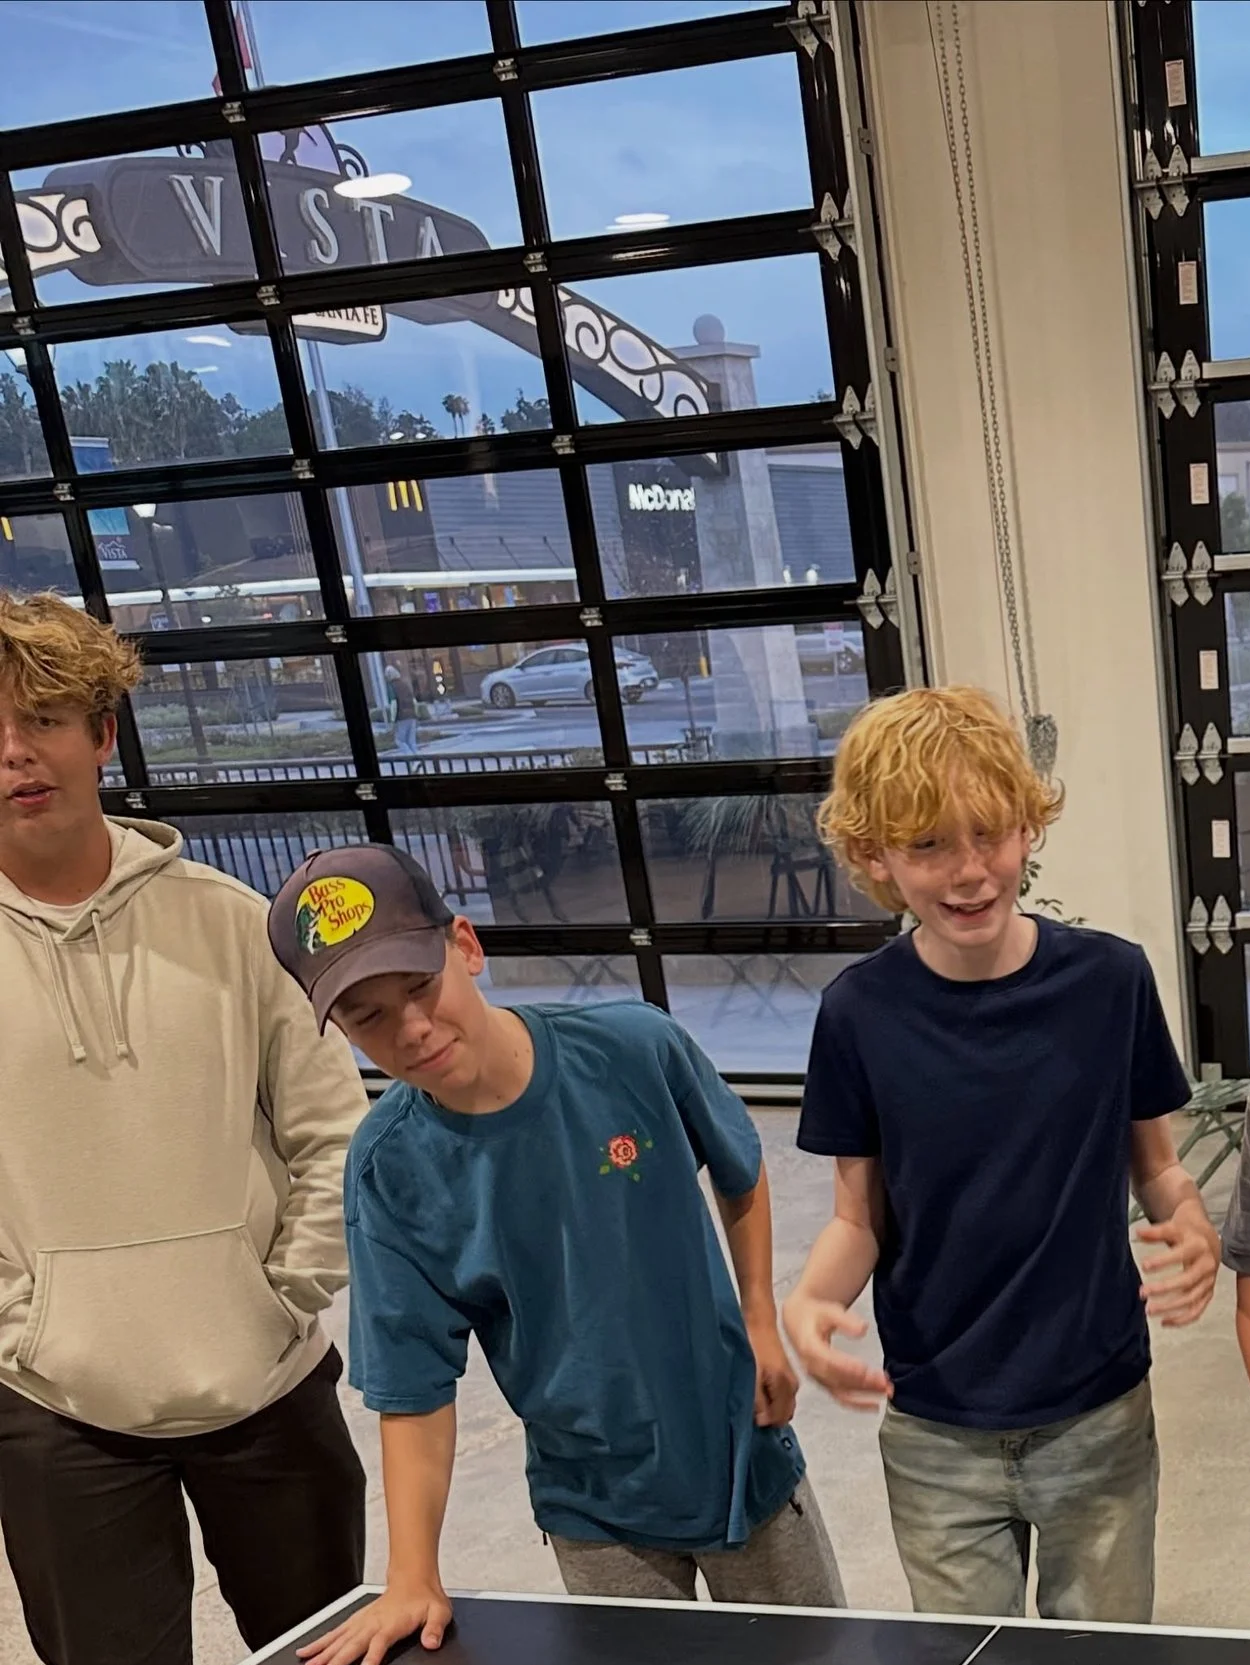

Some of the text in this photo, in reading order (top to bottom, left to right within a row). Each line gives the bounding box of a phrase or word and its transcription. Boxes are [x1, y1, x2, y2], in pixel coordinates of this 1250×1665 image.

[168, 174, 445, 265] VSTA
[101, 547, 128, 559] VISTA
[308, 878, 346, 905] Bass
[318, 895, 345, 917] Pro
[328, 901, 372, 929] Shops
